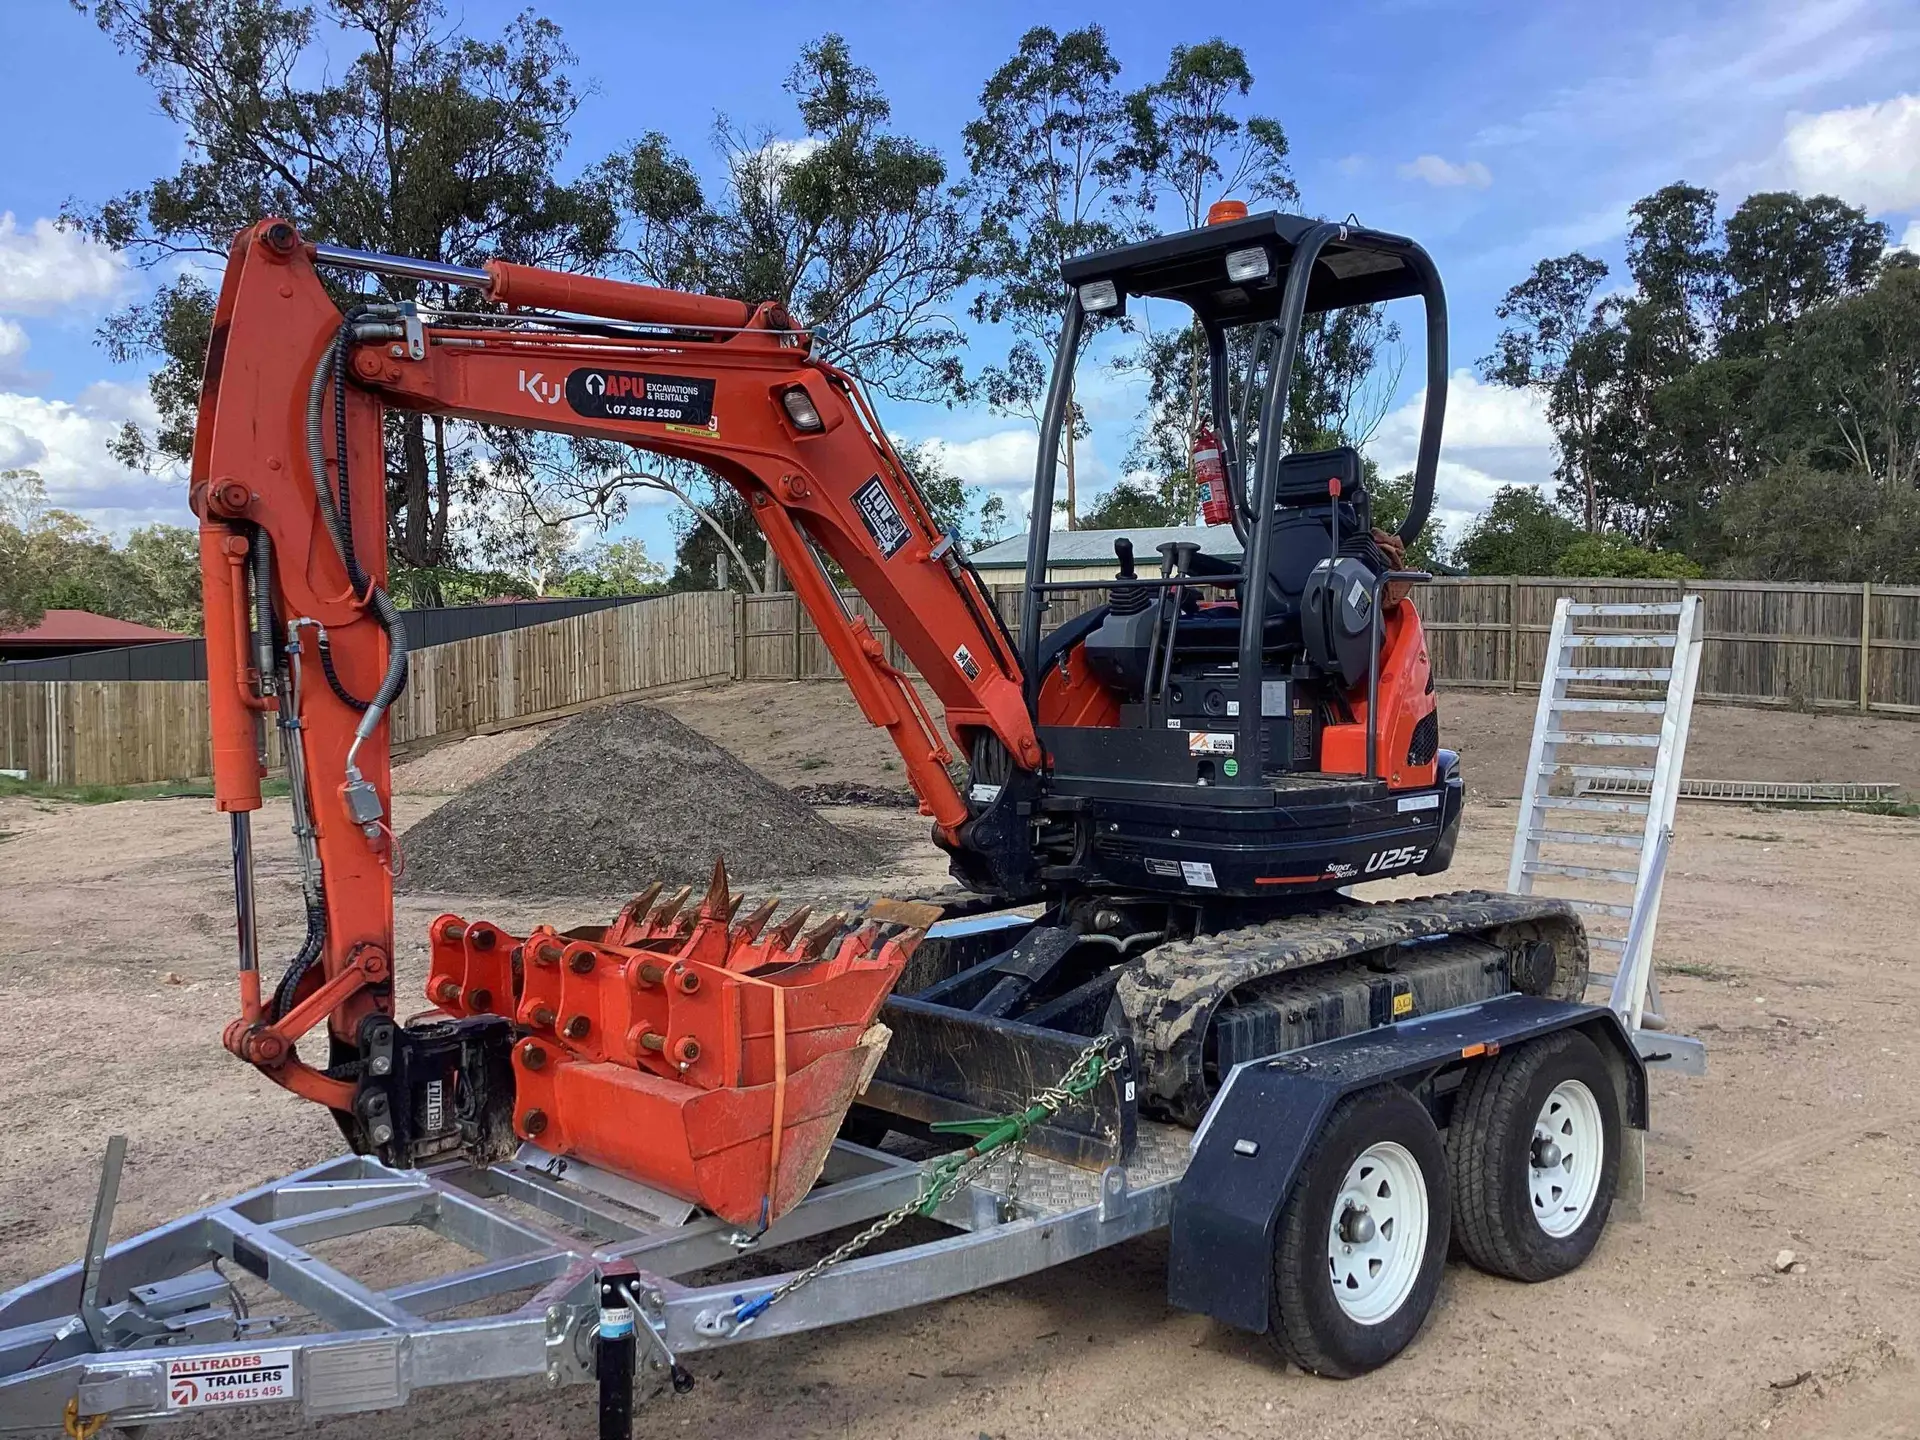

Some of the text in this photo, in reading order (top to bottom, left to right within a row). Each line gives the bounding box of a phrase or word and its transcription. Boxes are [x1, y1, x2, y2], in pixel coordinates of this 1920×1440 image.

[606, 375, 645, 398] APU
[646, 383, 699, 396] EXCAVATIONS
[647, 392, 689, 403] & RENTALS
[613, 405, 682, 419] 07 3812 2580
[869, 487, 893, 521] LUV
[863, 497, 893, 541] YA DIGGER
[1364, 845, 1428, 873] U25-3
[1325, 863, 1351, 873] Super
[1334, 868, 1359, 879] Series
[171, 1355, 261, 1373] ALLTRADES
[206, 1371, 281, 1387] TRAILERS
[204, 1385, 283, 1403] 0434 615 495
